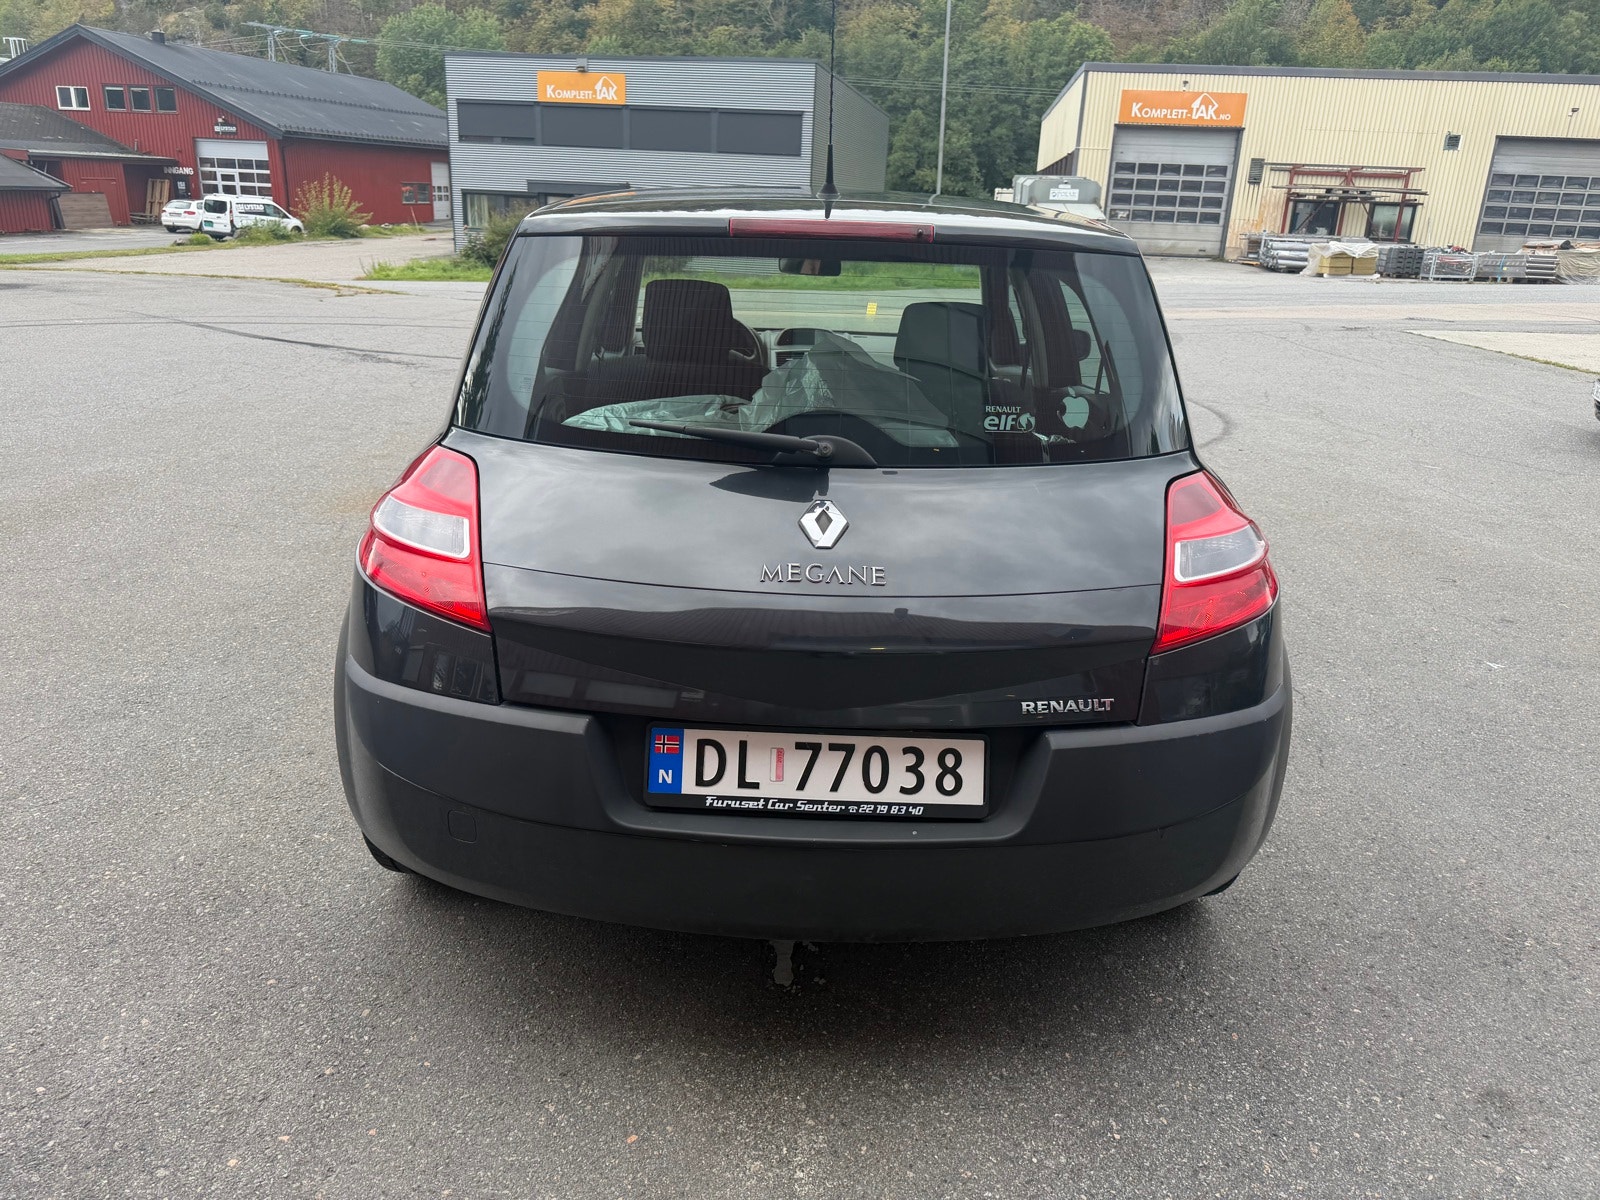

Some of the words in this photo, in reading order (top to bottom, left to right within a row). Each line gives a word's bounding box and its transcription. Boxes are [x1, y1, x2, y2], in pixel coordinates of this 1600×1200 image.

[163, 166, 194, 176] INNGANG
[985, 405, 1021, 413] RENAULT
[983, 414, 1017, 431] elf
[760, 562, 887, 586] MEGANE
[1020, 698, 1115, 715] RENAULT
[694, 738, 761, 790] DL
[794, 741, 964, 797] 77038
[658, 769, 673, 785] N
[705, 796, 765, 809] Furuset
[767, 799, 794, 810] Car
[795, 800, 845, 812] Senter
[858, 804, 874, 813] 22
[876, 804, 889, 814] 19
[890, 805, 907, 815] 83
[908, 806, 924, 815] 40
